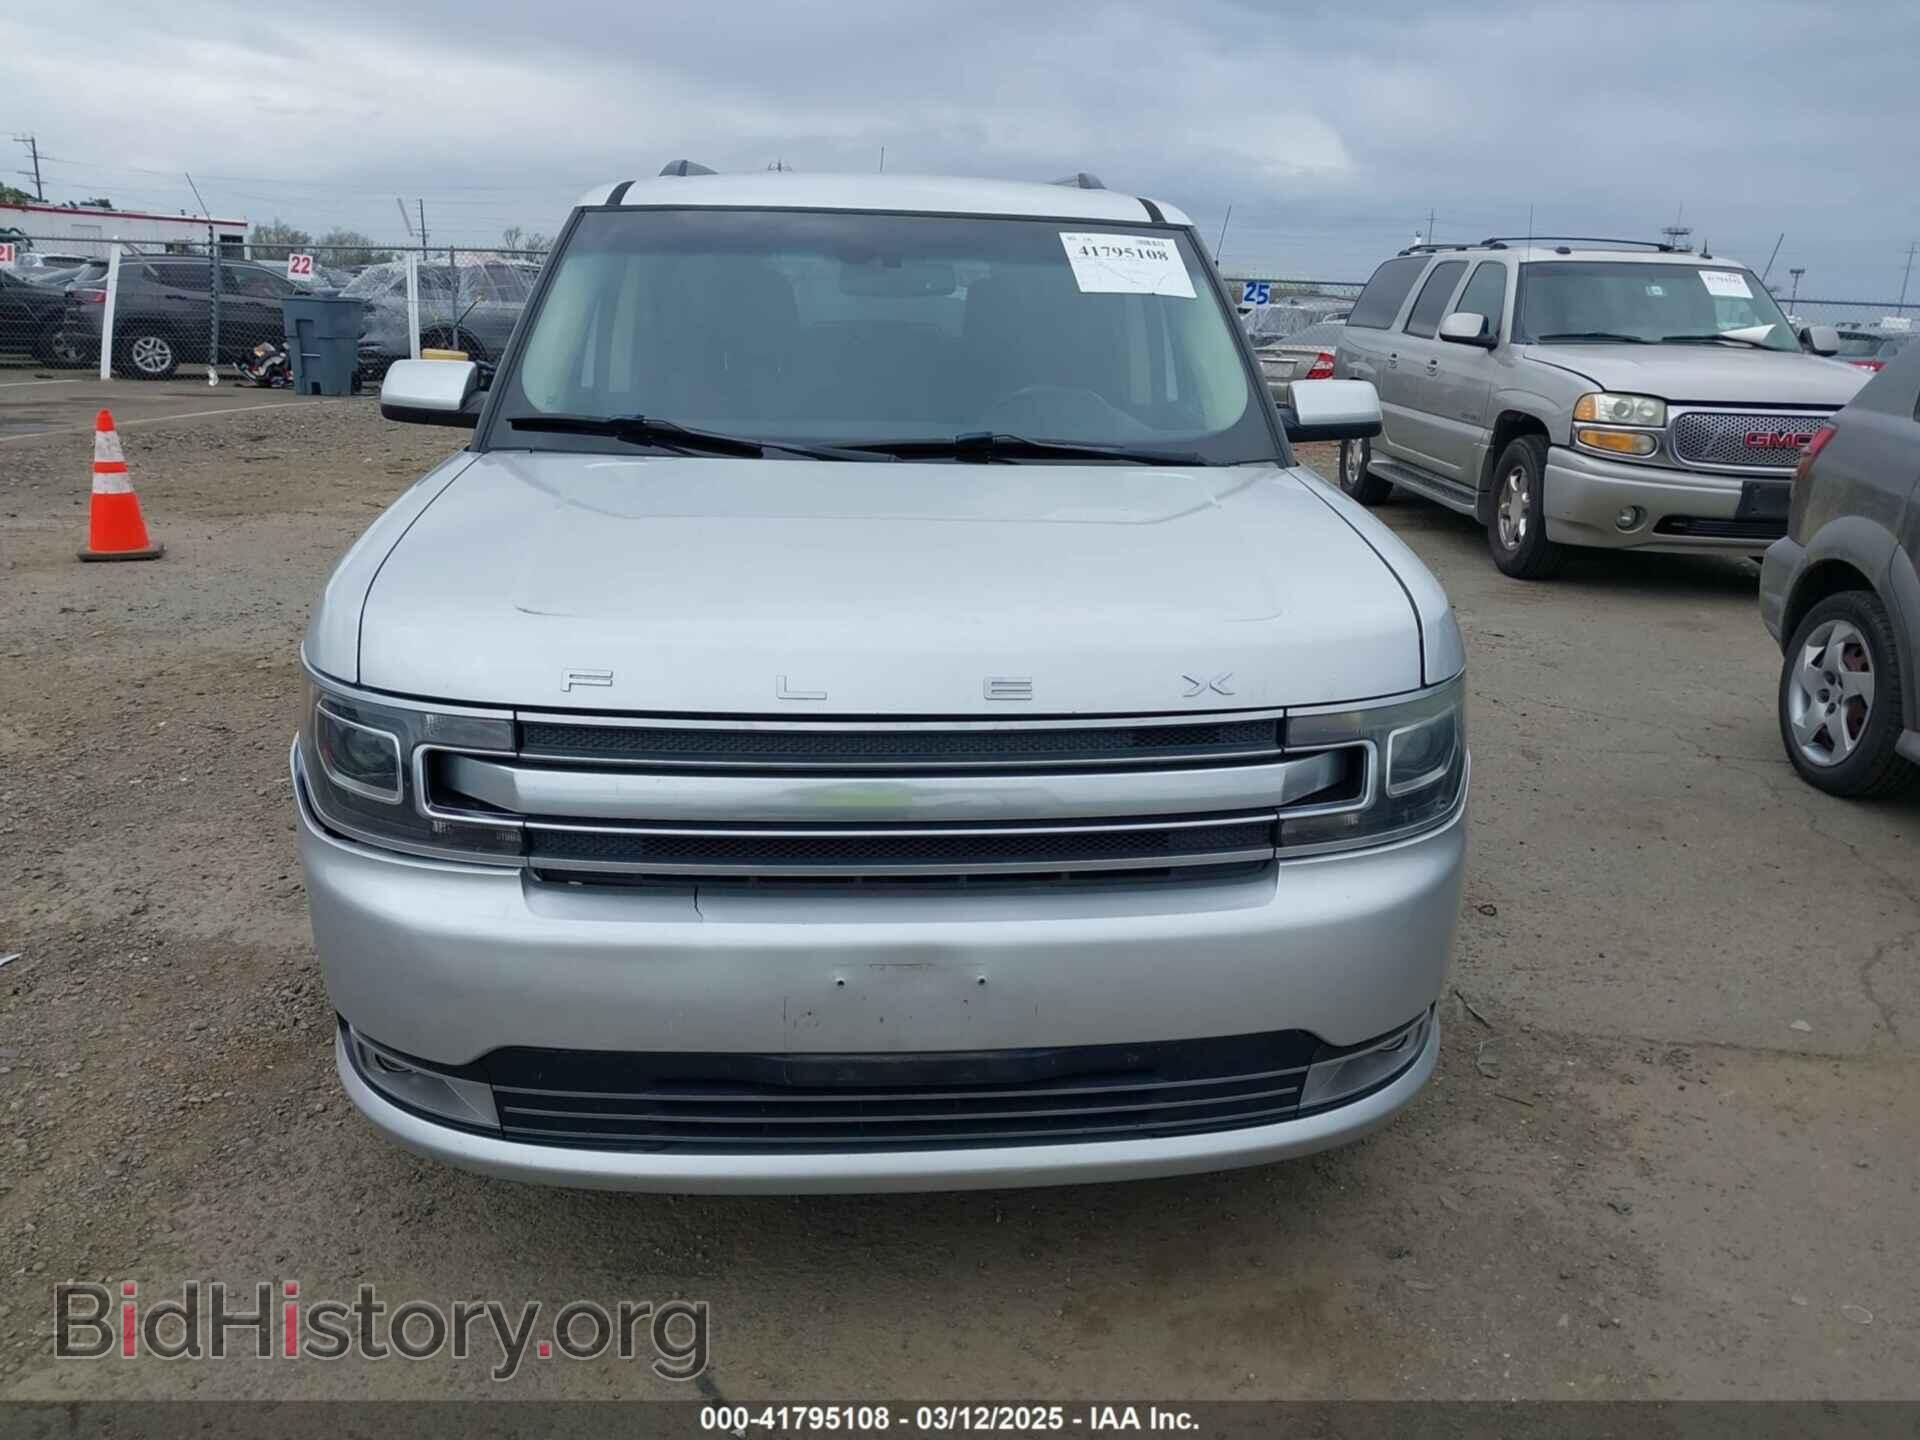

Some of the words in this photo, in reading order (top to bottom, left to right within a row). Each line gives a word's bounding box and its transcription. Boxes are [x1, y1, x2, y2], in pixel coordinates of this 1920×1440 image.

[1079, 245, 1169, 261] 41795108
[290, 256, 310, 274] 22
[1244, 282, 1270, 304] 25
[1745, 431, 1815, 448] GMC
[560, 668, 1235, 701] FLEX
